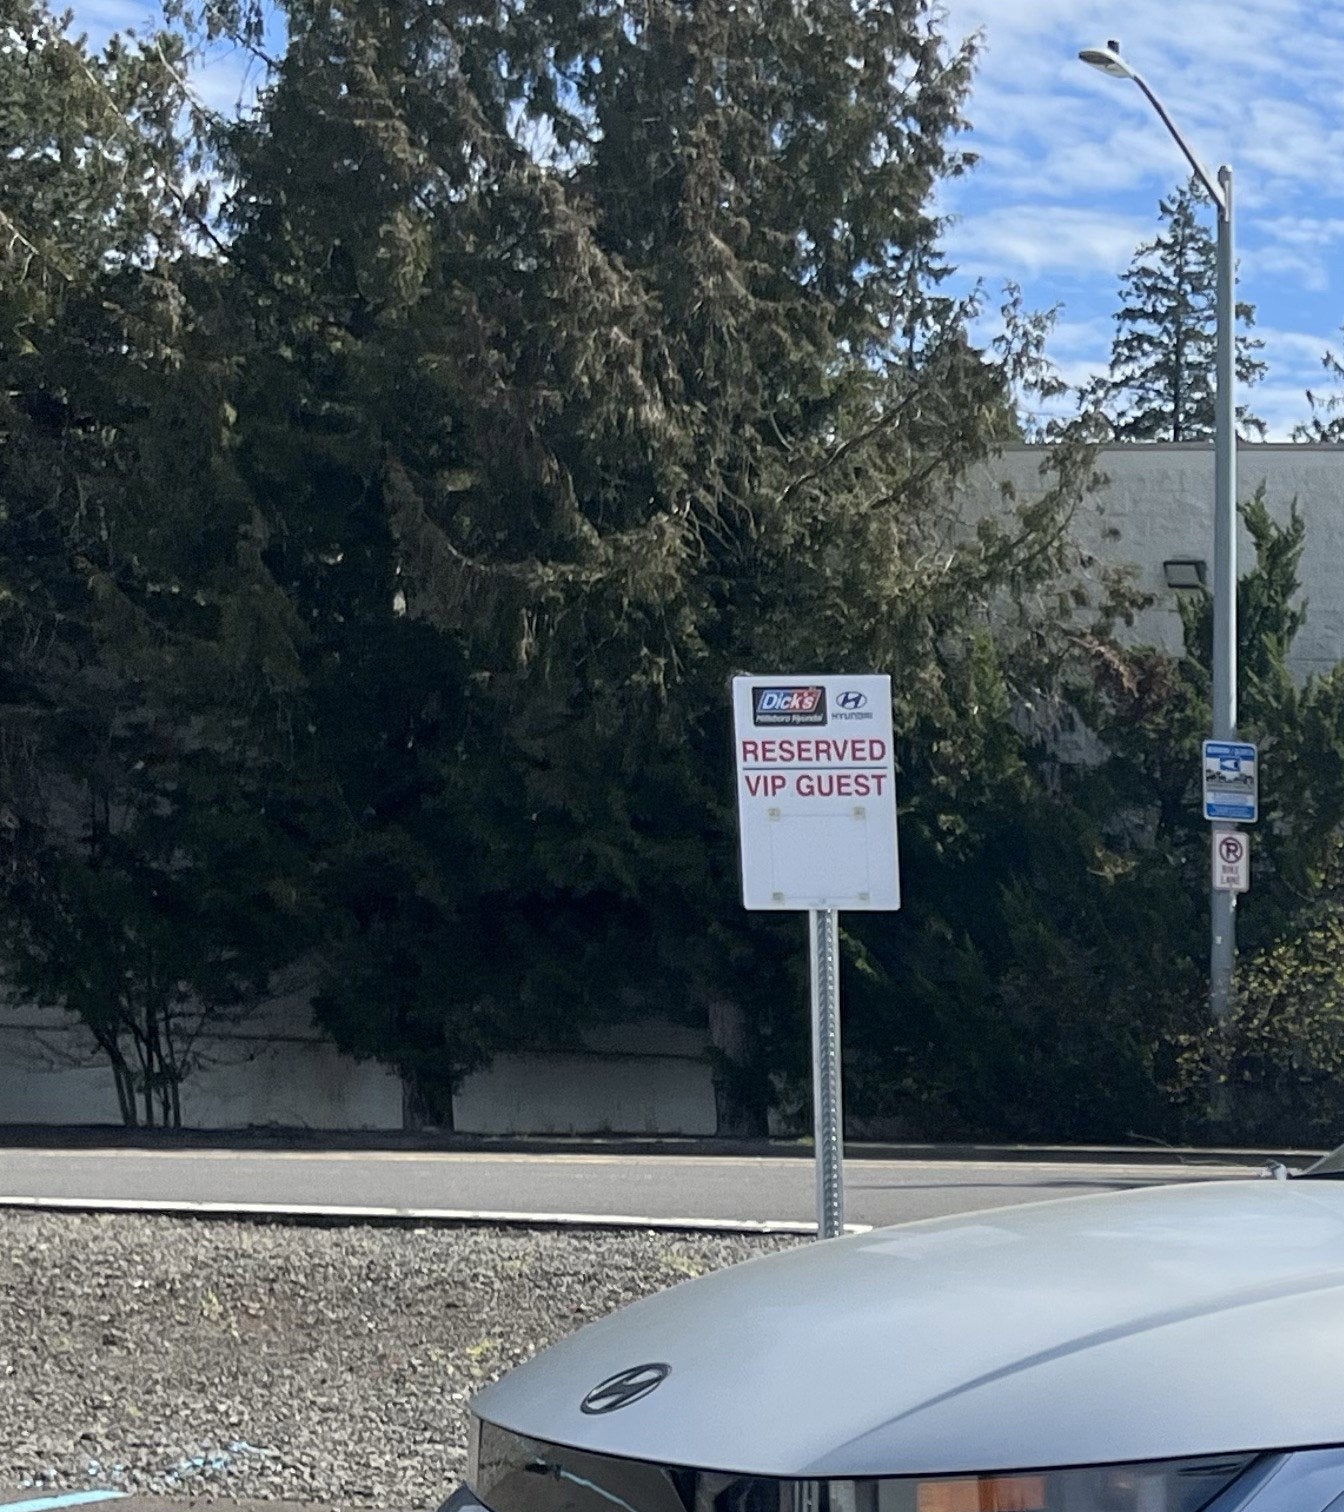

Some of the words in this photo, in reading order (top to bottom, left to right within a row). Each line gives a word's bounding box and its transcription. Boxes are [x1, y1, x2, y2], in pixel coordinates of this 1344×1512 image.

[761, 692, 815, 710] Dick's
[742, 740, 887, 763] RESERVED
[745, 775, 787, 797] VIP
[796, 774, 887, 796] GUEST
